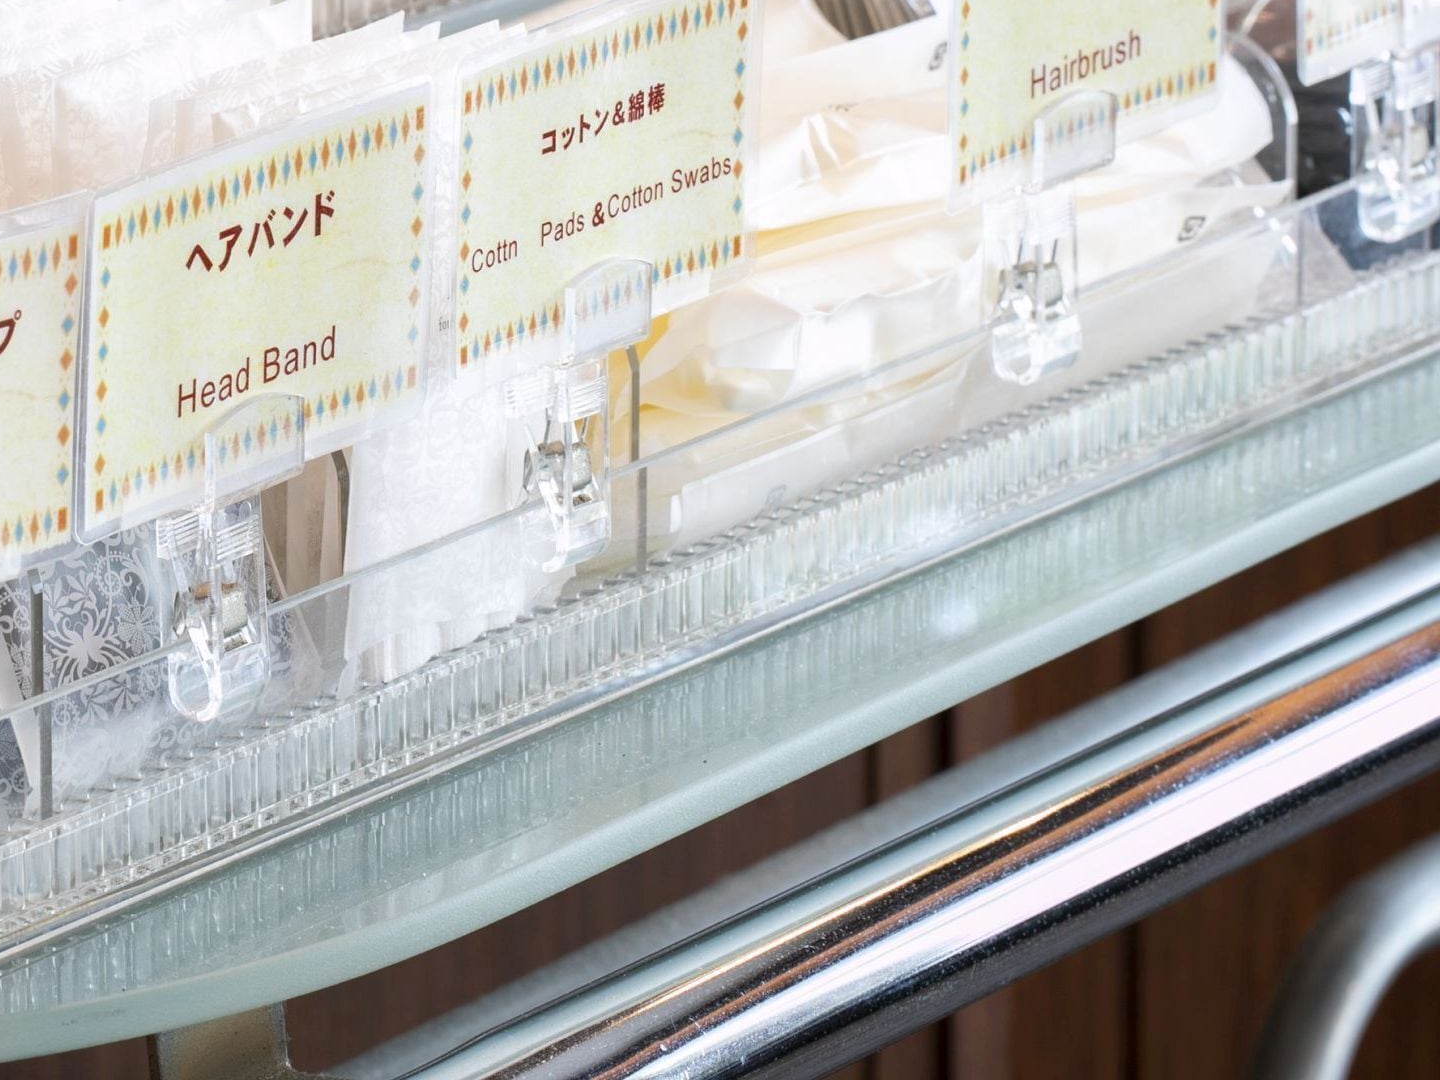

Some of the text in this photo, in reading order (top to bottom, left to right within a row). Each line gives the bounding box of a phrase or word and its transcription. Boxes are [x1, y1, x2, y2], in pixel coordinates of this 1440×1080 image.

[1031, 29, 1142, 99] Hairbrush
[185, 190, 336, 272] ヘアバンド
[471, 239, 518, 274] Cottn
[540, 212, 585, 248] Pads
[671, 156, 732, 194] Swabs
[177, 325, 336, 418] Head Band
